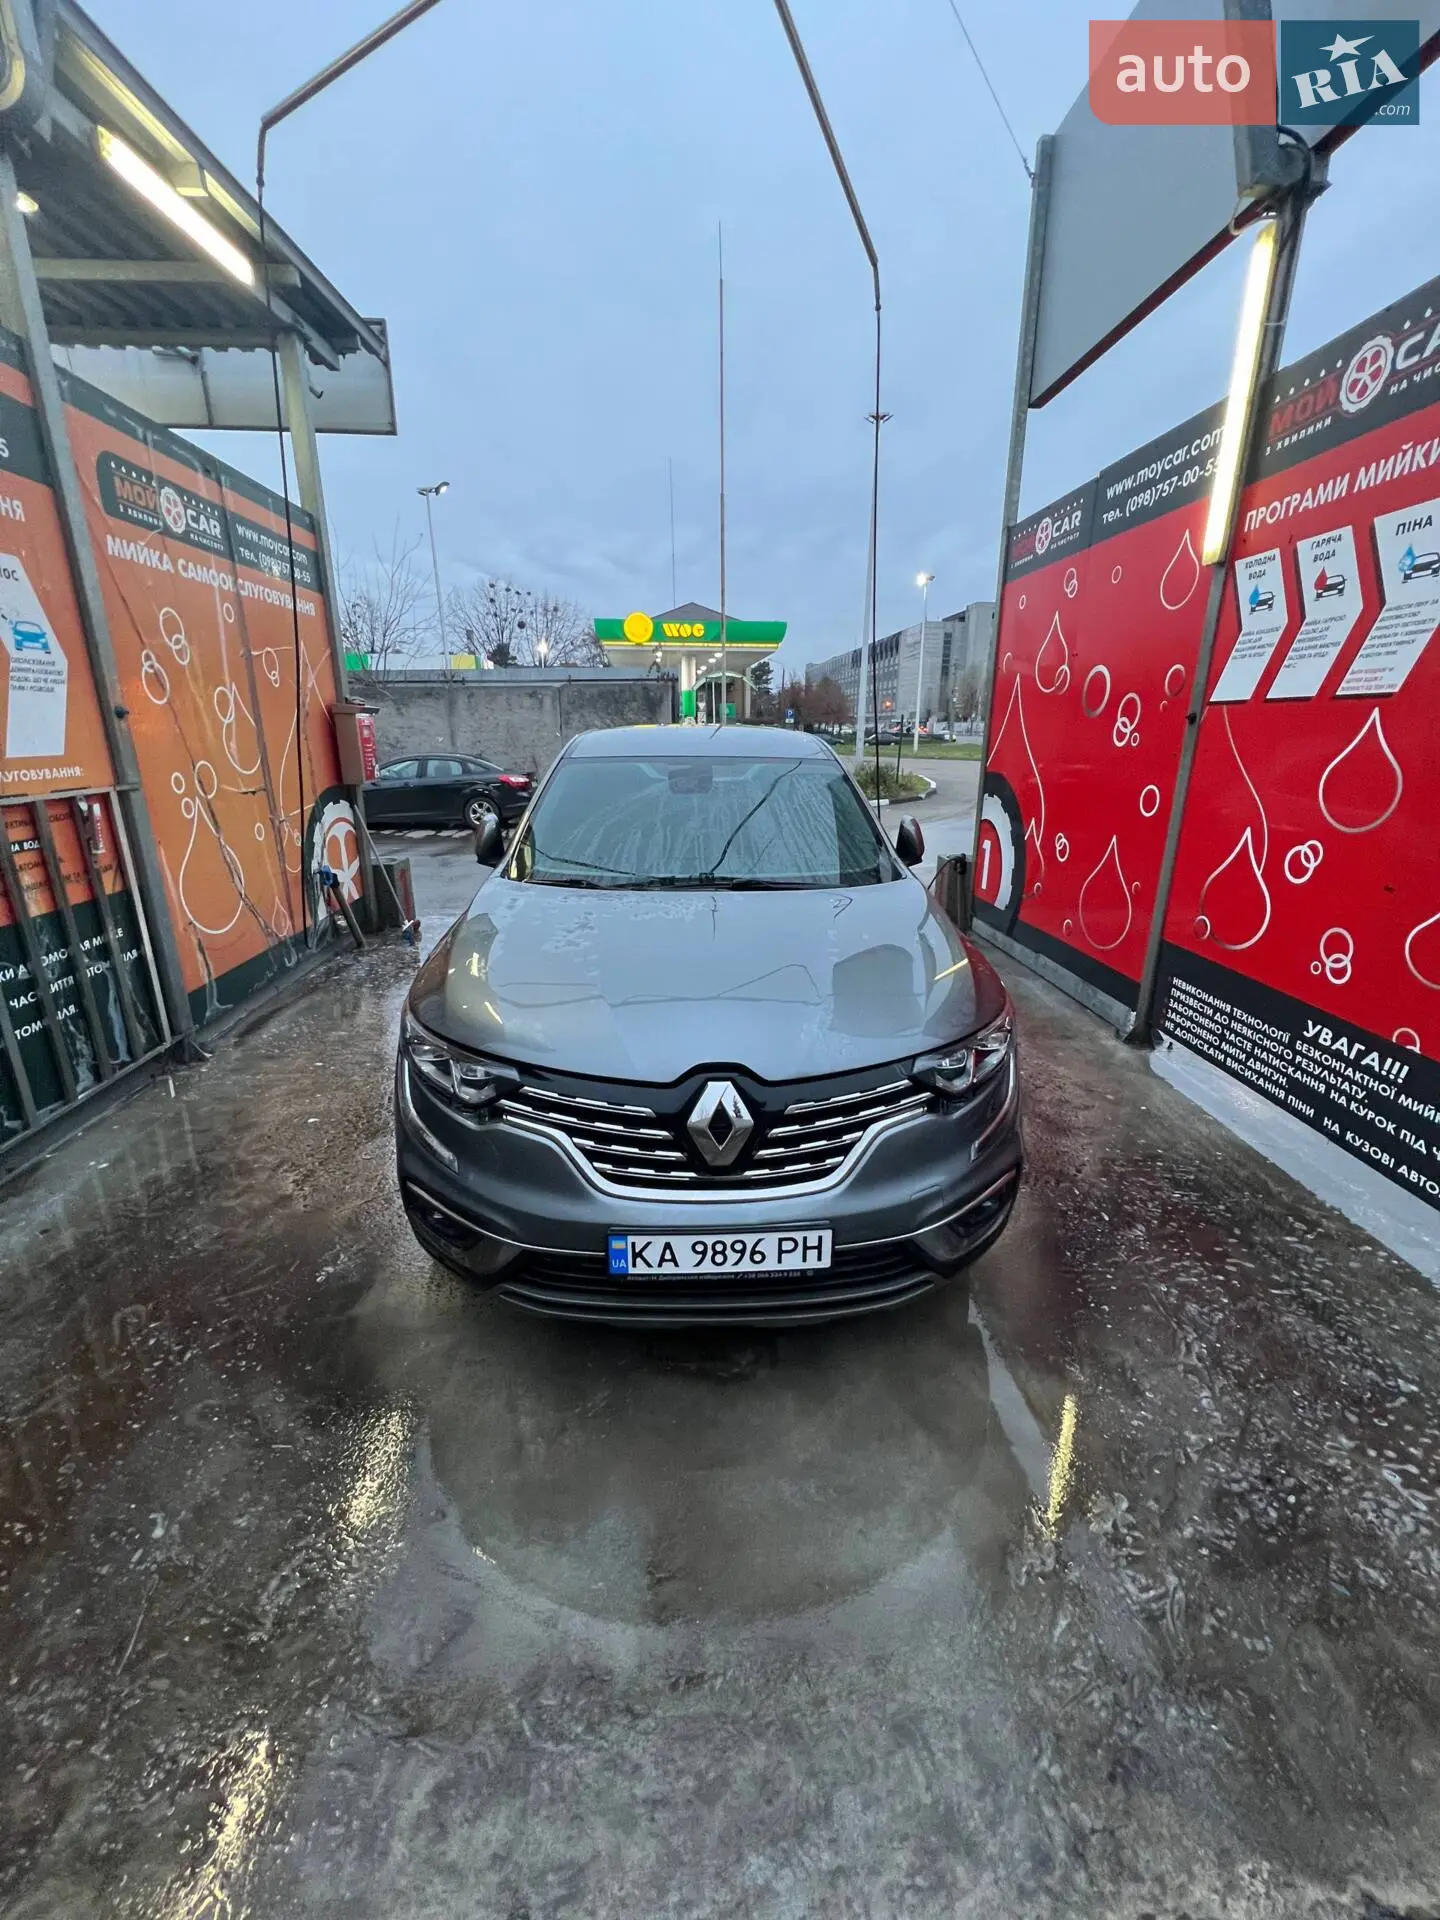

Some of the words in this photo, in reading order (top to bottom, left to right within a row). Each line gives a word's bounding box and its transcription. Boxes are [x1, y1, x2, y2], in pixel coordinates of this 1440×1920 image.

[1275, 416, 1333, 451] ХВИЛИНИ
[1388, 379, 1408, 394] НА
[1102, 510, 1123, 525] тел.
[1244, 472, 1351, 533] ПРОГРАМИ
[186, 508, 222, 539] CAR
[1051, 509, 1082, 538] CAR
[1396, 514, 1433, 537] ПІНА
[106, 534, 174, 574] МИЙКА
[239, 547, 257, 563] тел.
[1310, 533, 1343, 551] ГАРЯЧА
[1313, 549, 1337, 563] ВОДА
[1244, 553, 1277, 570] ХОЛОДНА
[1248, 569, 1267, 581] ВОДА
[662, 623, 705, 638] WOG
[981, 839, 991, 890] 1
[9, 991, 38, 1009] ЧАС
[1166, 1009, 1220, 1046] ЗАБОРОНЕНО
[1220, 1041, 1246, 1062] МИТИ
[1247, 1058, 1289, 1088] ДВИГУН.
[1170, 987, 1213, 1017] ПРИЗВЕСТИ
[1213, 1012, 1229, 1025] ДО
[1230, 1020, 1293, 1060] НЕЯКІСНОГО
[1294, 1056, 1369, 1103] РЕЗУЛЬТАТУ.
[1172, 976, 1231, 1014] НЕВИКОНАННЯ
[1232, 1006, 1291, 1044] ТЕХНОЛОГІЇ
[1295, 1040, 1397, 1099] БЕЗКОНТАКТНОЇ
[1303, 1019, 1410, 1084] УВАГА!!!
[1168, 998, 1222, 1034] ЗАБОРОНЕНО
[1223, 1028, 1253, 1052] ЧАСТЕ
[1254, 1046, 1326, 1095] НАТИСКАННЯ
[1329, 1089, 1347, 1107] НА
[1349, 1100, 1398, 1136] КУРОК
[1400, 1128, 1427, 1154] ПІД
[1164, 1020, 1175, 1032] НЕ
[1174, 1027, 1225, 1062] ДОПУСКАТИ
[1226, 1057, 1285, 1100] ВИСИХАННЯ
[1287, 1095, 1315, 1119] ПІНИ
[1323, 1117, 1341, 1135] НА
[1345, 1131, 1395, 1168] КУЗОВІ
[1397, 1165, 1440, 1199] АВТО
[612, 1259, 627, 1268] UA
[630, 1241, 680, 1269] KA
[690, 1238, 767, 1268] 9896
[777, 1235, 823, 1264] PH
